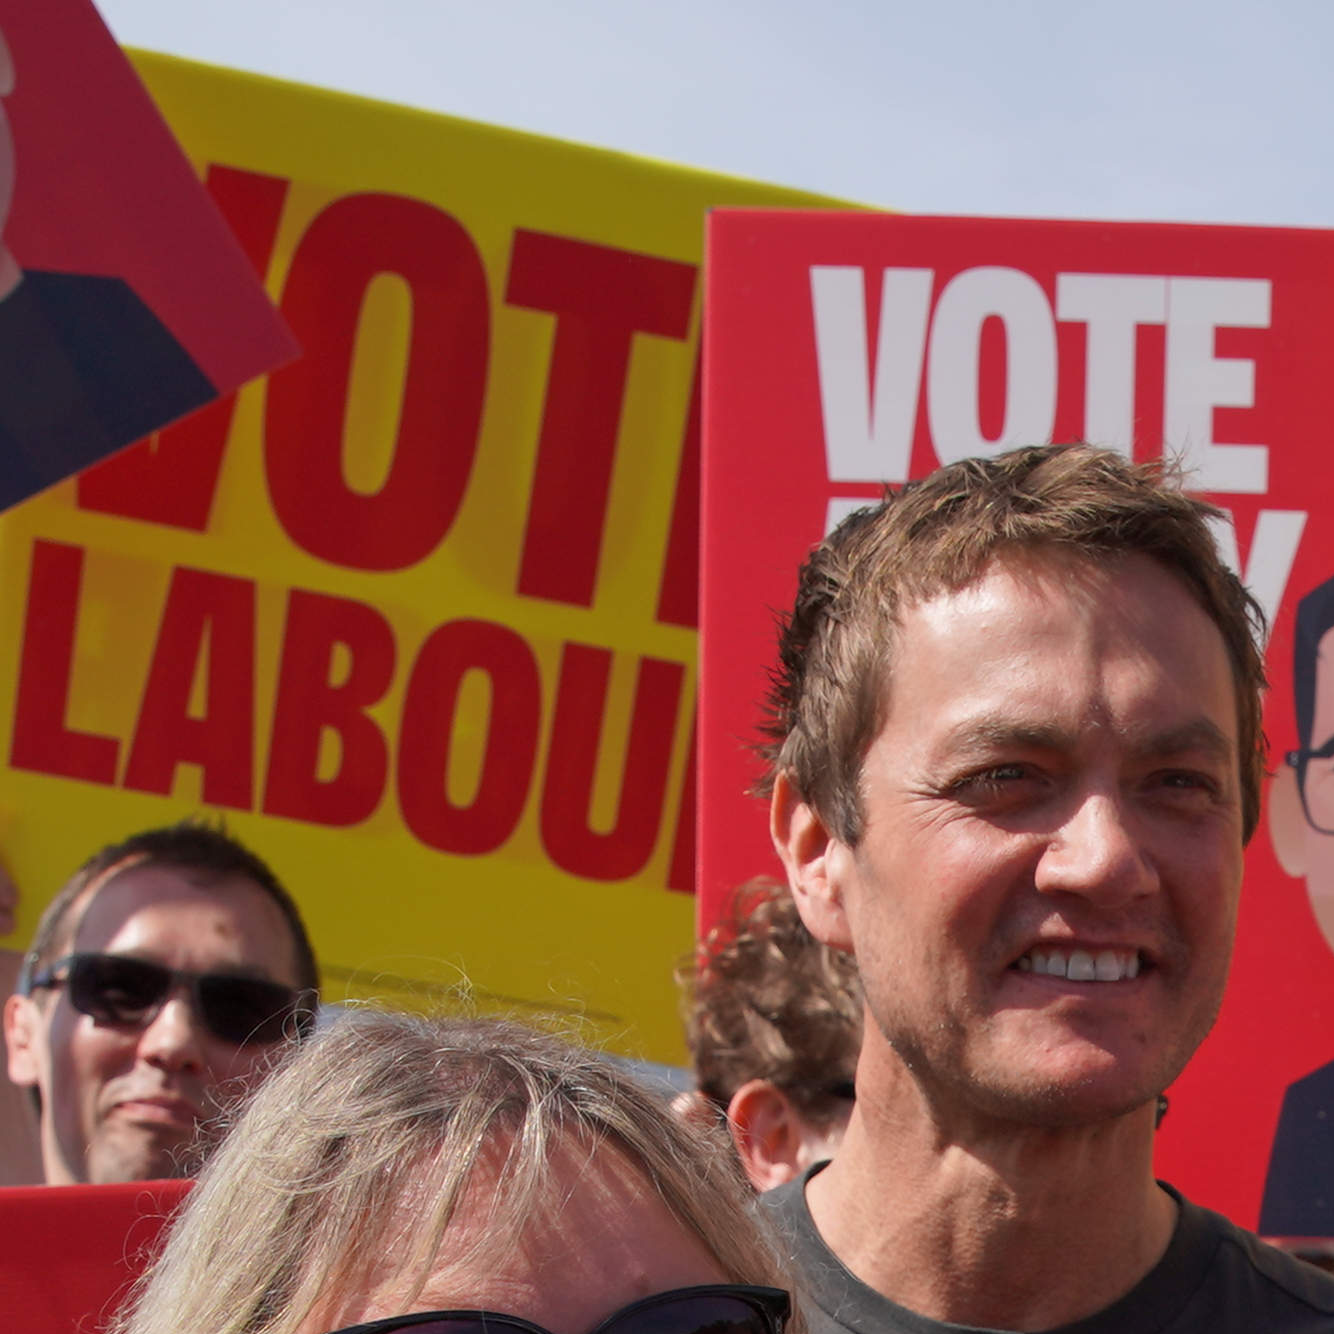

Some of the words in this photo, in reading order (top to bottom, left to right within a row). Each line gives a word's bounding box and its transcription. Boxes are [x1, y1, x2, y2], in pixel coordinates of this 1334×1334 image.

[76, 162, 703, 632] OT
[809, 265, 1271, 493] VOTE
[8, 536, 698, 896] LABOU
